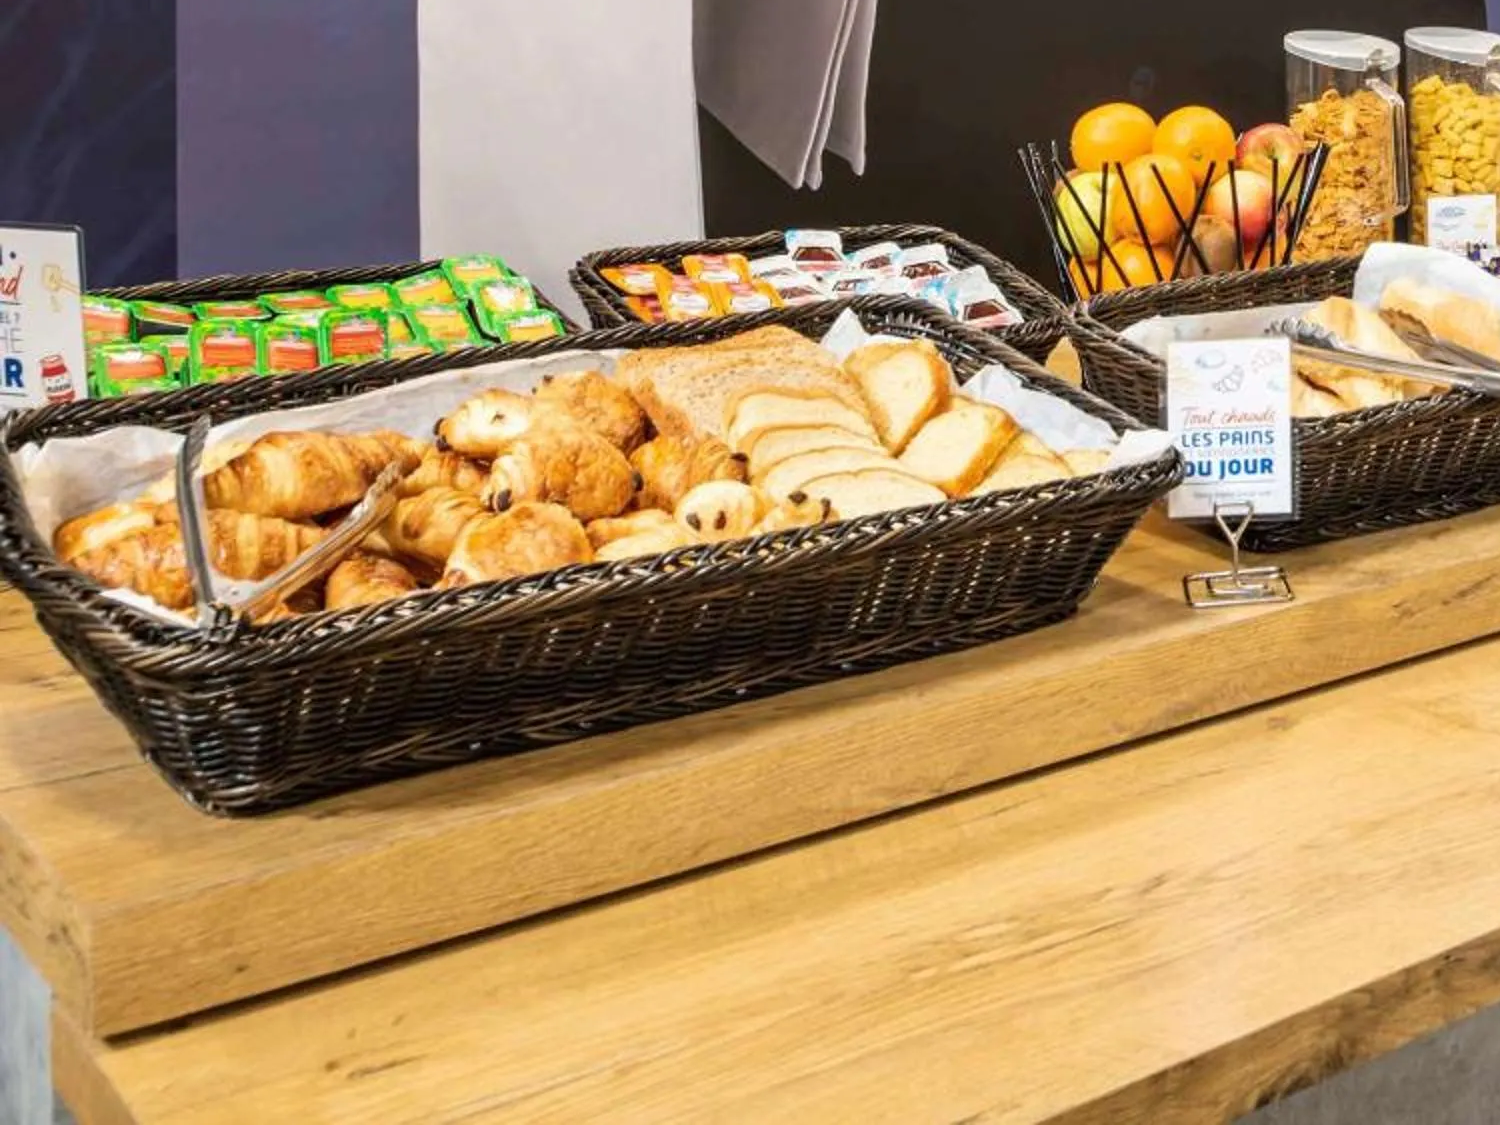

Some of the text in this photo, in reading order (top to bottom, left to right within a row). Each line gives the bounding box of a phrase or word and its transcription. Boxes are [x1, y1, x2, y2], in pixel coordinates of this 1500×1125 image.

[1181, 430, 1275, 448] LES PAINS
[1183, 458, 1273, 480] DU JOUR
